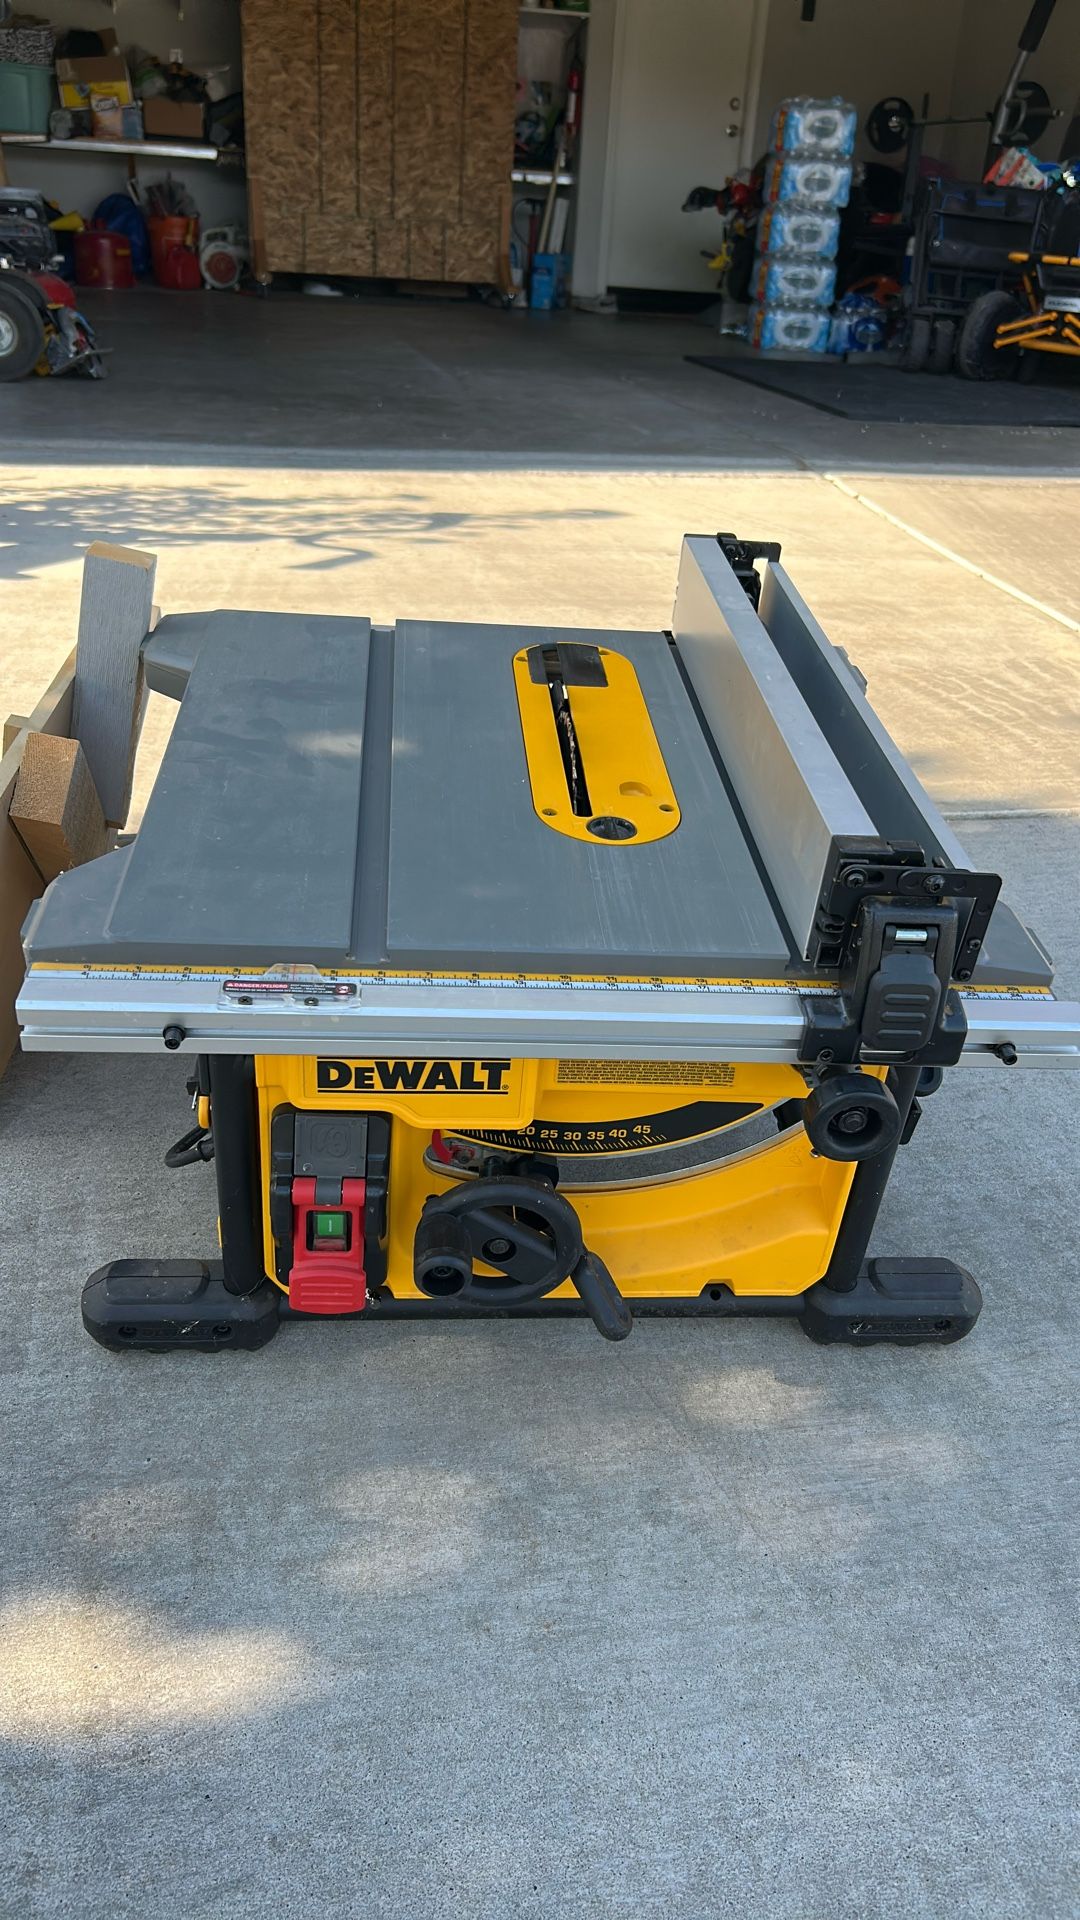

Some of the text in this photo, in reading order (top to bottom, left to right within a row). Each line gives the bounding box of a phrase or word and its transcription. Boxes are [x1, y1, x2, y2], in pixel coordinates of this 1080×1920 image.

[316, 1061, 510, 1090] DEWALT
[517, 1125, 651, 1141] 20 25 30 35 40 45
